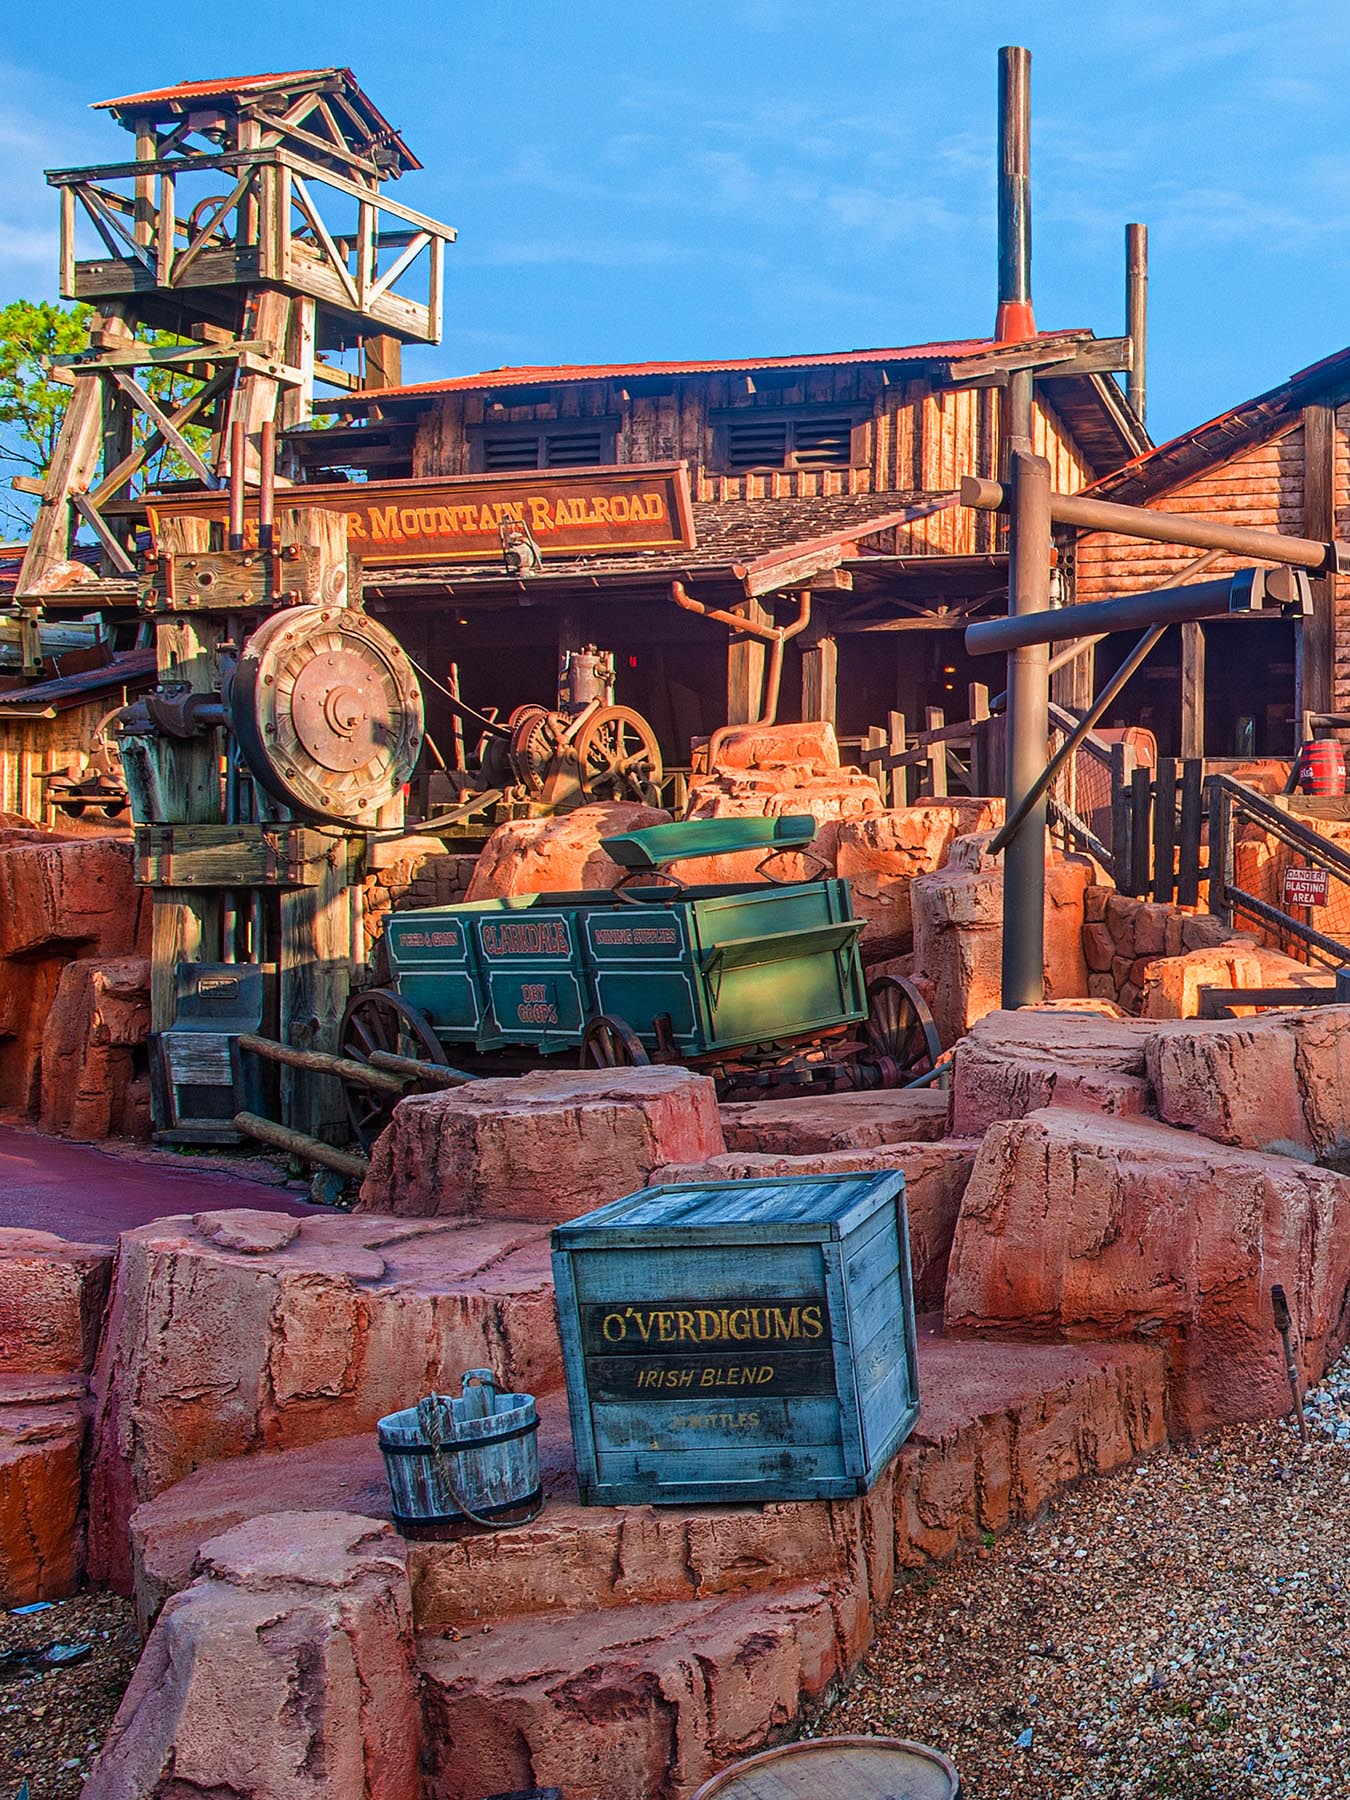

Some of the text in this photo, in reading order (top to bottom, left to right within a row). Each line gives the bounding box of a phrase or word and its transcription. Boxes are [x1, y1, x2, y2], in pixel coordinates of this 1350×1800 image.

[368, 504, 525, 542] MOUNTAIN
[528, 494, 664, 534] RAILROAD
[1286, 881, 1325, 893] BLASTING
[1292, 892, 1315, 903] AREA
[483, 922, 569, 955] CLARKDALE
[595, 928, 677, 944] MINING SUPPLIES
[521, 984, 547, 1003] DRY
[602, 1305, 824, 1343] O'VERDIGUMS
[636, 1366, 774, 1388] IRISH BLEND
